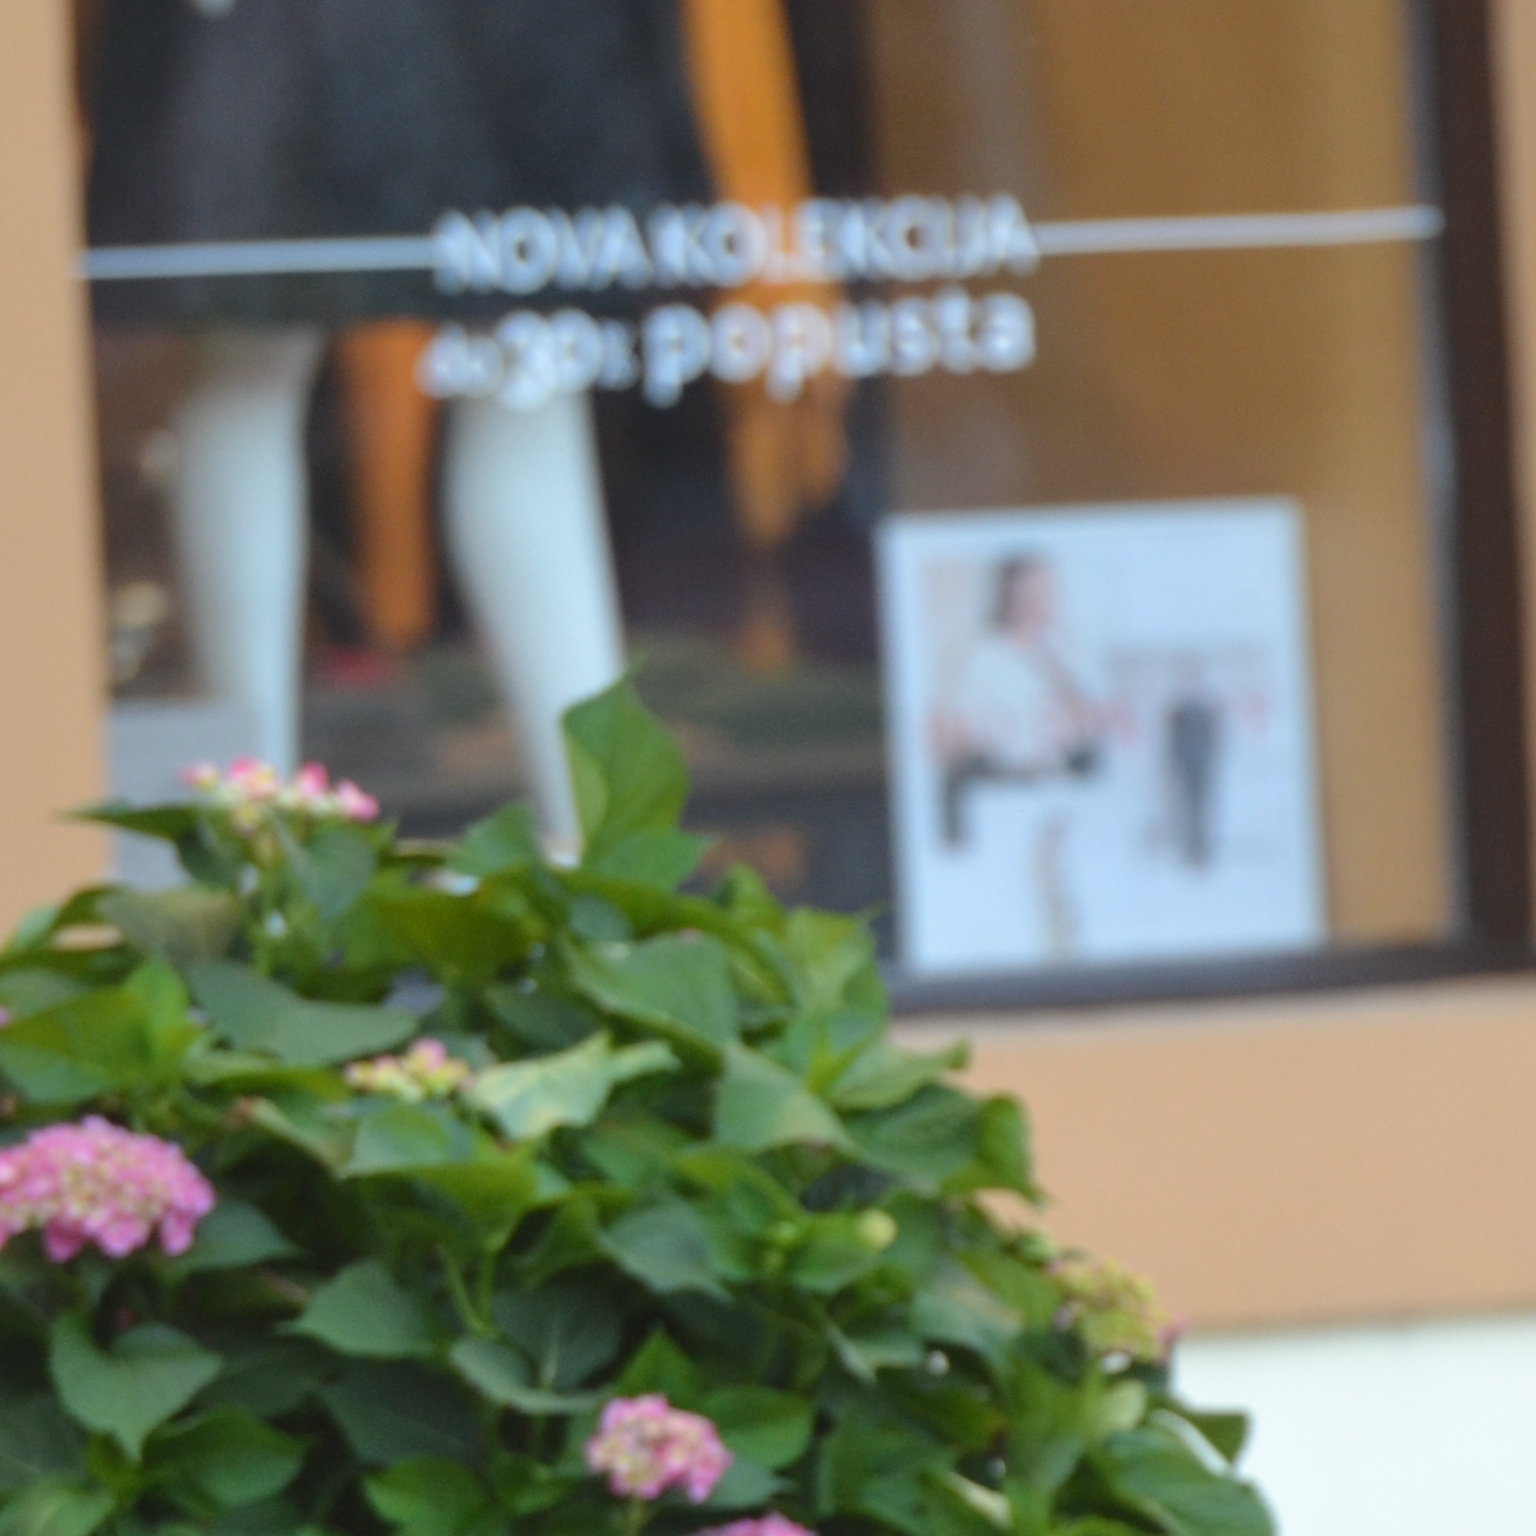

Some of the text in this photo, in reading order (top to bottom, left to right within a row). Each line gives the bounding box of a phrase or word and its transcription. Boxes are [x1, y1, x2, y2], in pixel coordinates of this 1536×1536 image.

[436, 196, 1039, 294] NOVA KOLEKCIJA
[644, 289, 1035, 406] popusta
